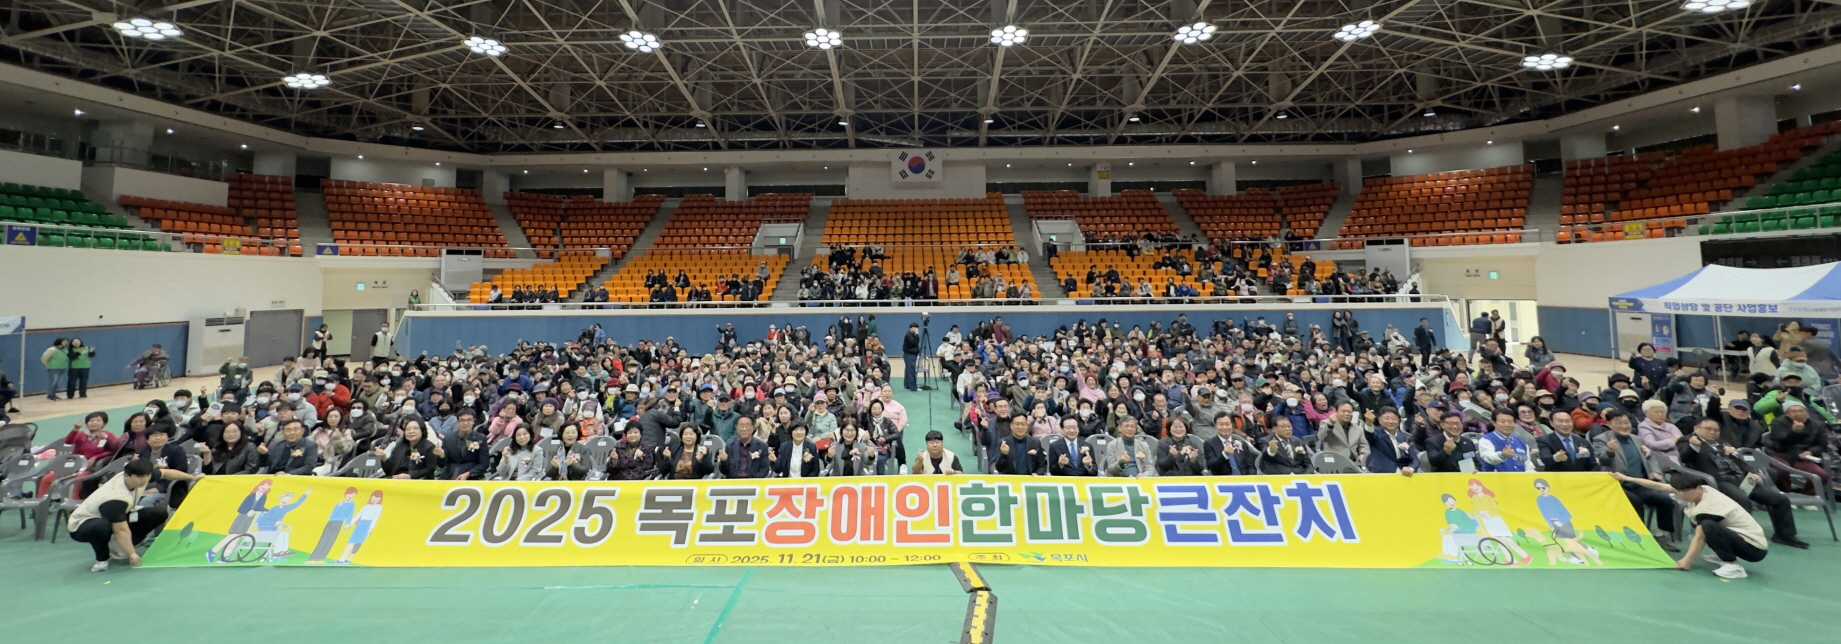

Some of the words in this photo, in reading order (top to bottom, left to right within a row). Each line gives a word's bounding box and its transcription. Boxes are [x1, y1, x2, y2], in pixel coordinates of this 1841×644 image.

[1663, 301, 1698, 312] 직업상담
[1713, 303, 1734, 313] 공단
[1737, 303, 1779, 314] 사업홍보
[429, 487, 617, 544] 2025
[849, 555, 886, 563] 10:00
[904, 554, 941, 562] 12:00
